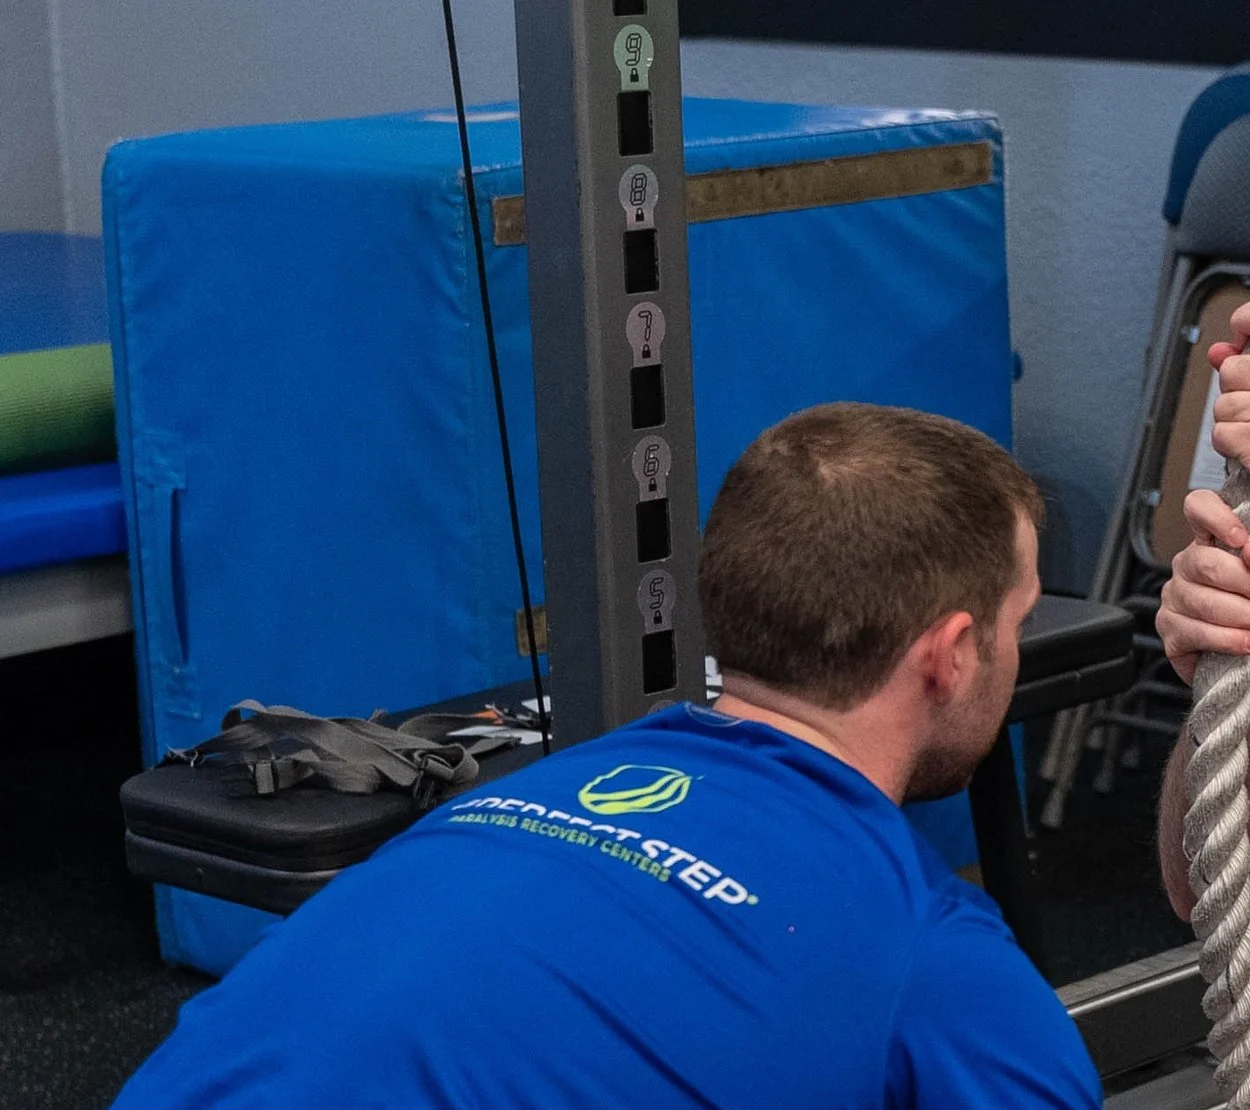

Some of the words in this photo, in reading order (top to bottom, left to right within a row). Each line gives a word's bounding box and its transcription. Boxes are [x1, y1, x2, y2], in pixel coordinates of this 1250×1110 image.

[626, 33, 642, 66] 9
[630, 173, 647, 206] 8
[638, 310, 653, 342] 7
[644, 444, 660, 477] 6
[650, 577, 664, 609] 5
[520, 818, 599, 847] RECOVERY
[600, 840, 671, 882] CENTERS
